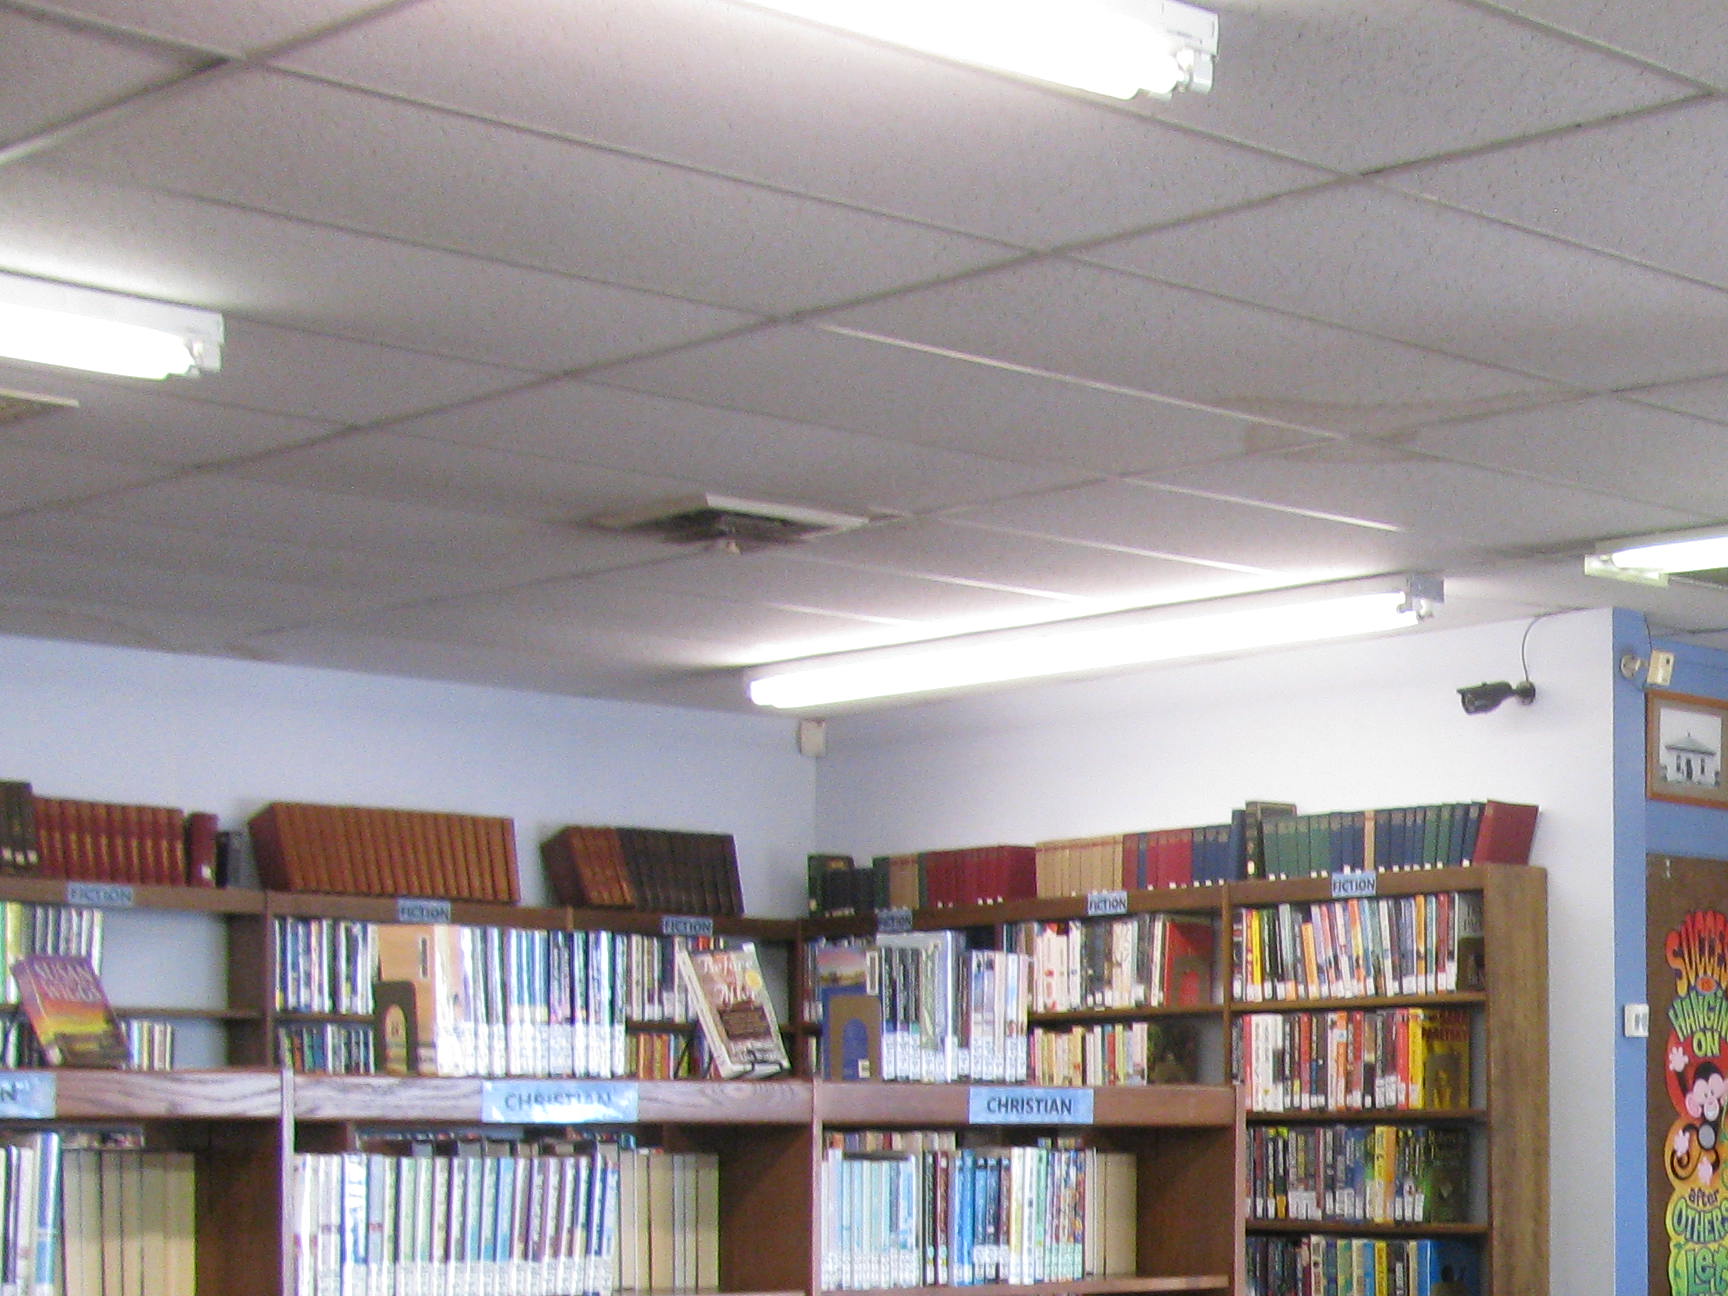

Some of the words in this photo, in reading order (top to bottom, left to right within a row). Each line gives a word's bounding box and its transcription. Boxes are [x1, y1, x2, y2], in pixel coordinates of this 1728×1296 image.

[1333, 878, 1376, 893] FICTION
[71, 886, 133, 902] FICTION
[400, 905, 450, 920] FICTION
[1089, 899, 1127, 912] FICTION
[664, 919, 712, 933] FICTION
[1693, 1031, 1720, 1057] ON
[986, 1096, 1073, 1115] CHRISTIAN
[1689, 1187, 1719, 1207] after
